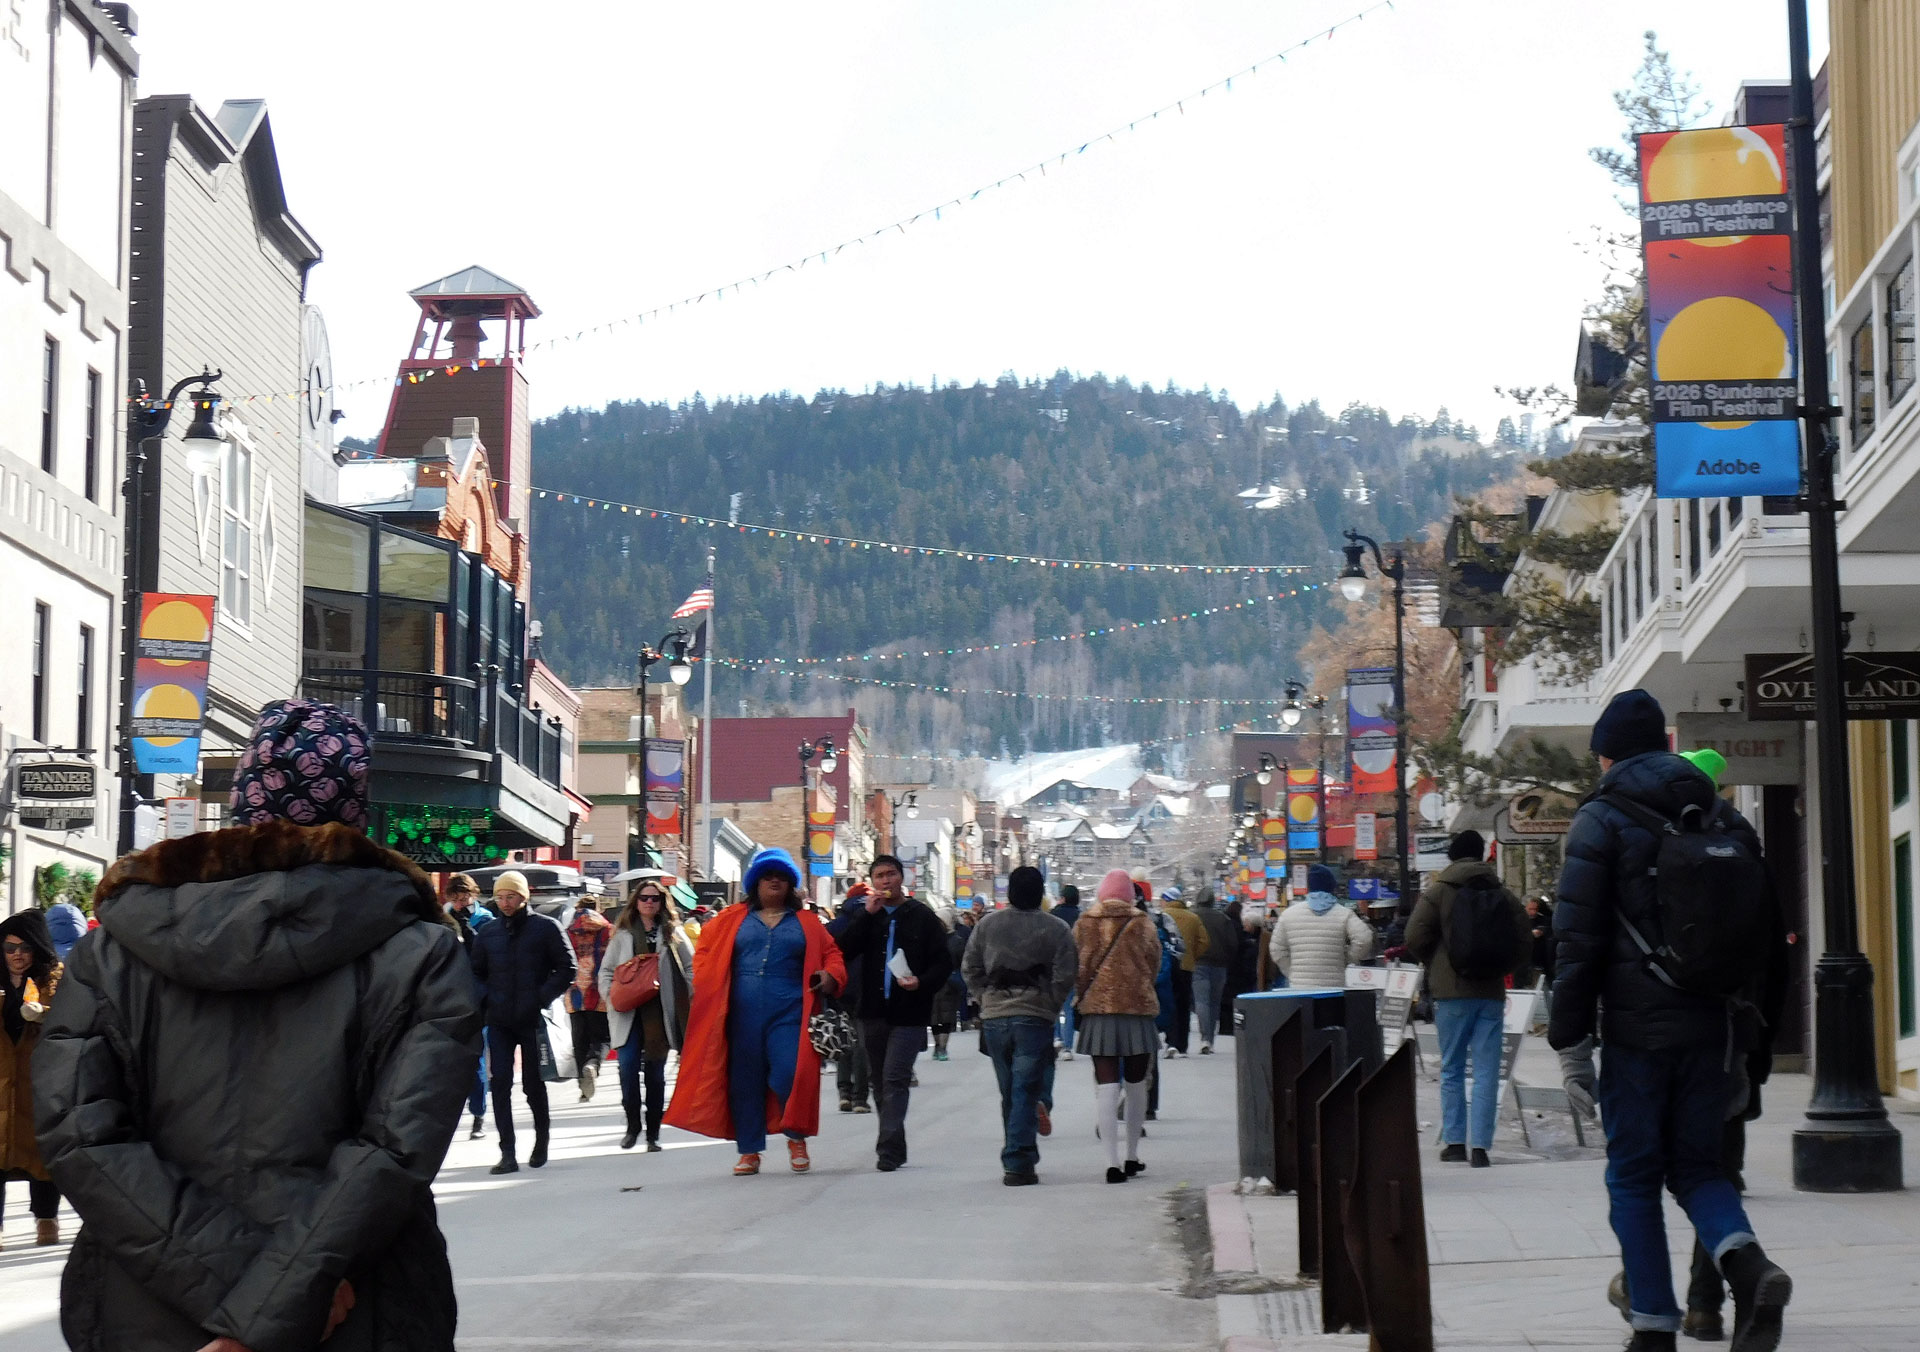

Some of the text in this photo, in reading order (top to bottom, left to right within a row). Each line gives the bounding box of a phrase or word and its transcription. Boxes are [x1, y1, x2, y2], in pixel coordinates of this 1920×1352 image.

[1644, 200, 1788, 220] 2026 Sundance
[1660, 214, 1775, 235] Film Festival
[1654, 383, 1796, 400] 2026 Sundance
[1668, 399, 1784, 417] Film Festival
[1696, 459, 1761, 475] Adobe
[1757, 680, 1920, 698] OVELAND
[21, 771, 93, 784] TANNER
[22, 783, 93, 792] TRADING
